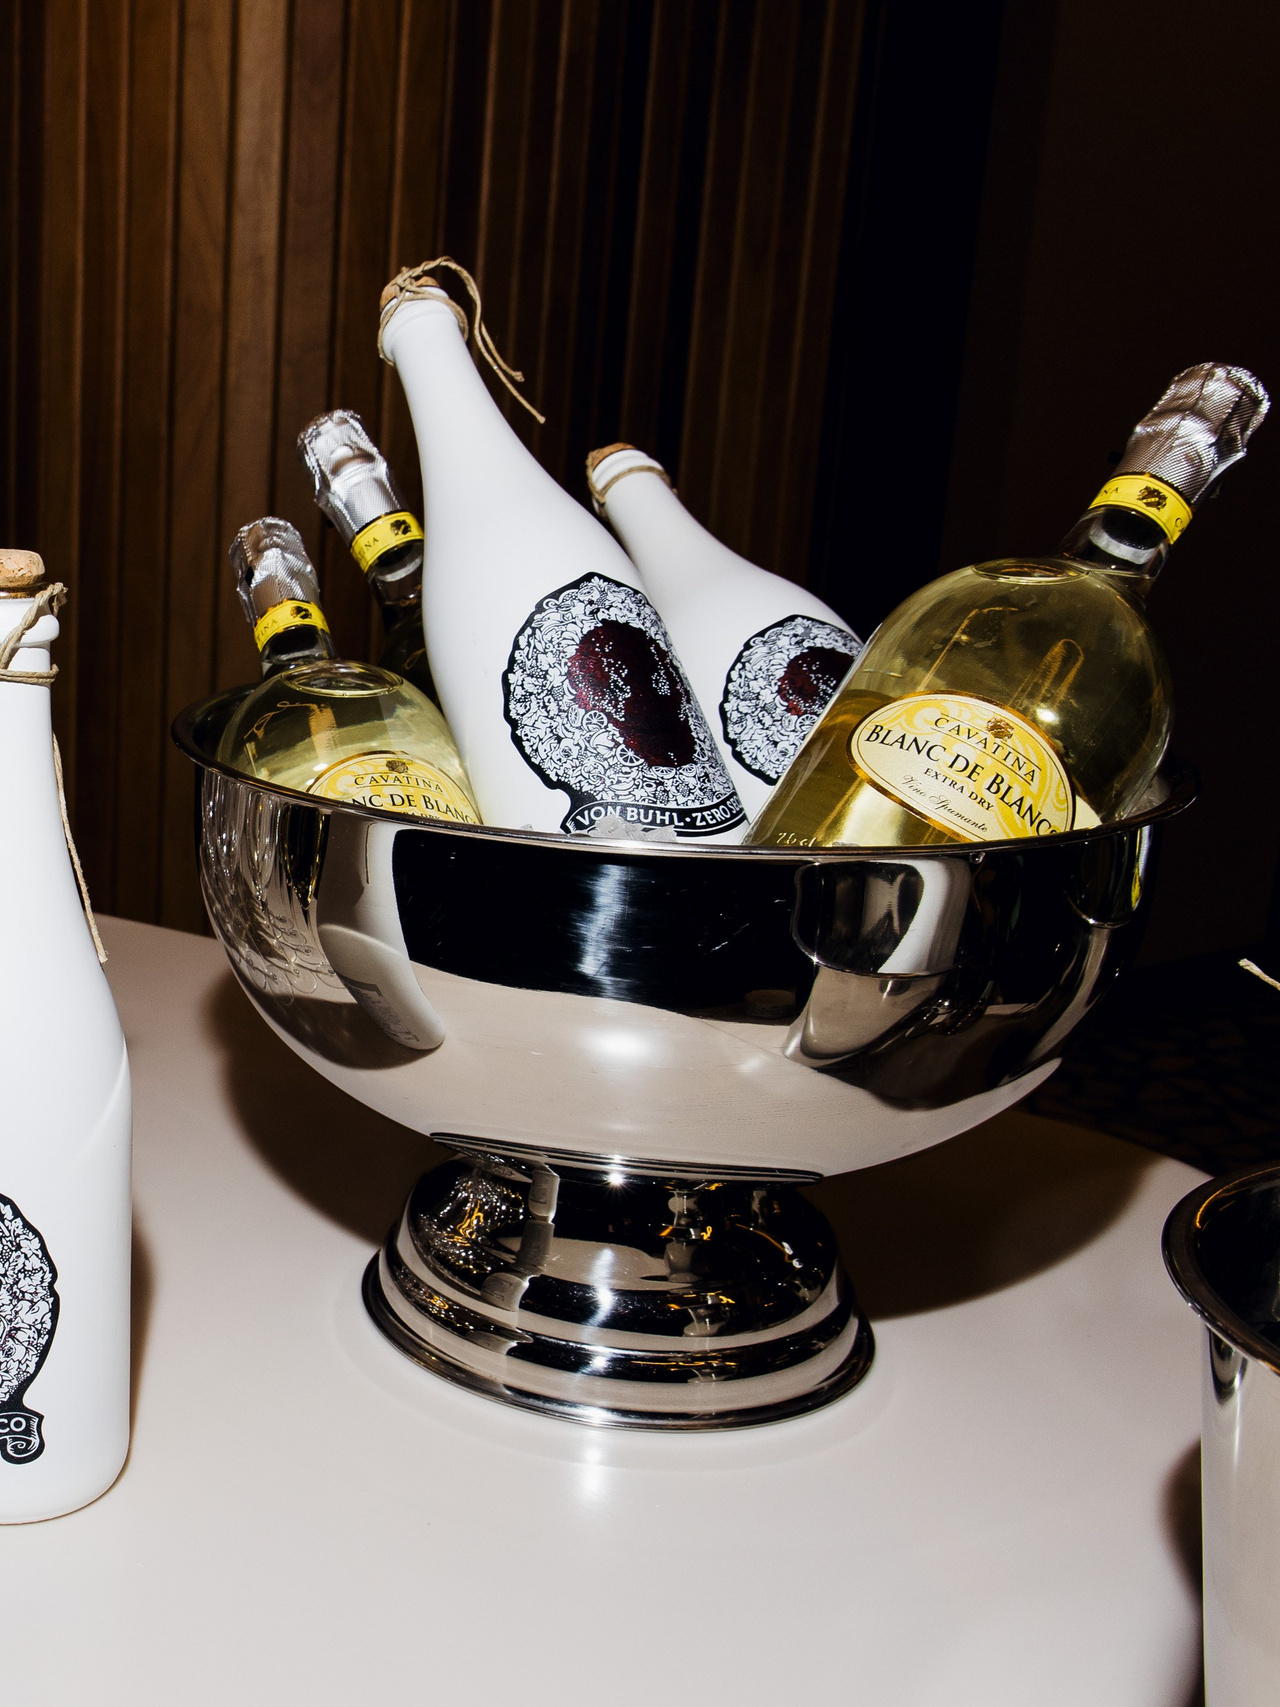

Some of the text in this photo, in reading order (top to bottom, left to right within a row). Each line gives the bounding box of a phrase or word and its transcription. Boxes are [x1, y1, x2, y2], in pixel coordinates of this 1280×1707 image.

[933, 716, 1038, 783] CAVATINA
[353, 774, 444, 793] CAVATINA
[864, 724, 1058, 837] BLANC DE BLANC
[923, 767, 995, 812] EXTRA DRY
[389, 793, 417, 808] DE
[421, 794, 477, 825] BLANC
[576, 805, 622, 827] VON
[626, 807, 685, 827] BUHL
[692, 804, 731, 827] ZERO
[902, 774, 989, 833] Vino Spumante
